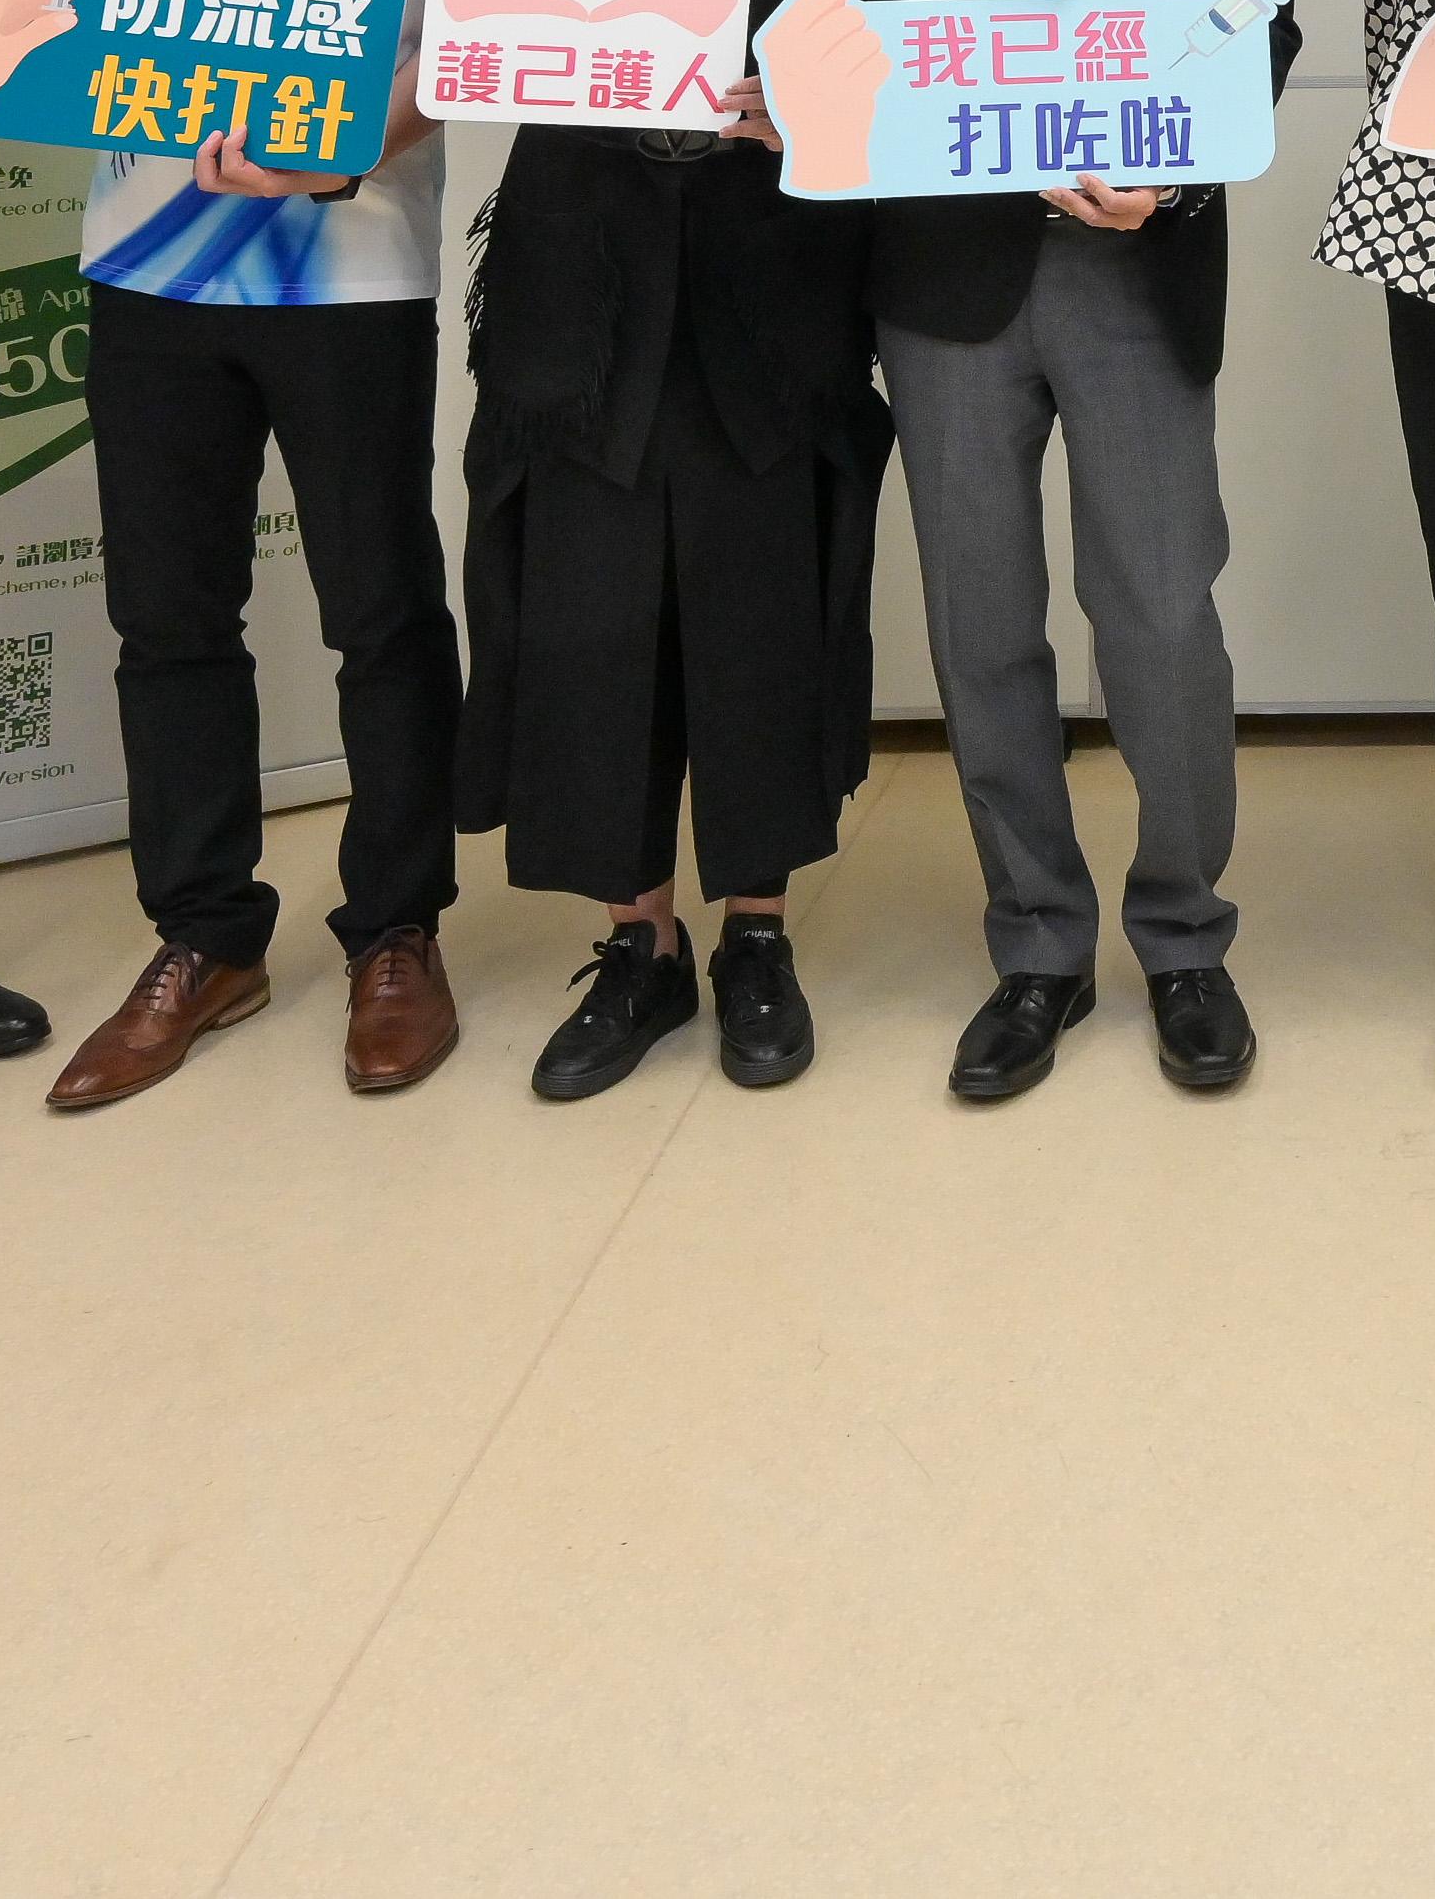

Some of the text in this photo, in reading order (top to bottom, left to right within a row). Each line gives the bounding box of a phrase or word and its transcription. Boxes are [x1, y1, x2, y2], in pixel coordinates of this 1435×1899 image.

[433, 39, 725, 114] 護己護人
[902, 10, 1150, 89] 我已經
[86, 54, 355, 162] 快打針
[948, 95, 1195, 177] 打咗啦
[31, 198, 52, 215] of
[282, 541, 301, 557] of
